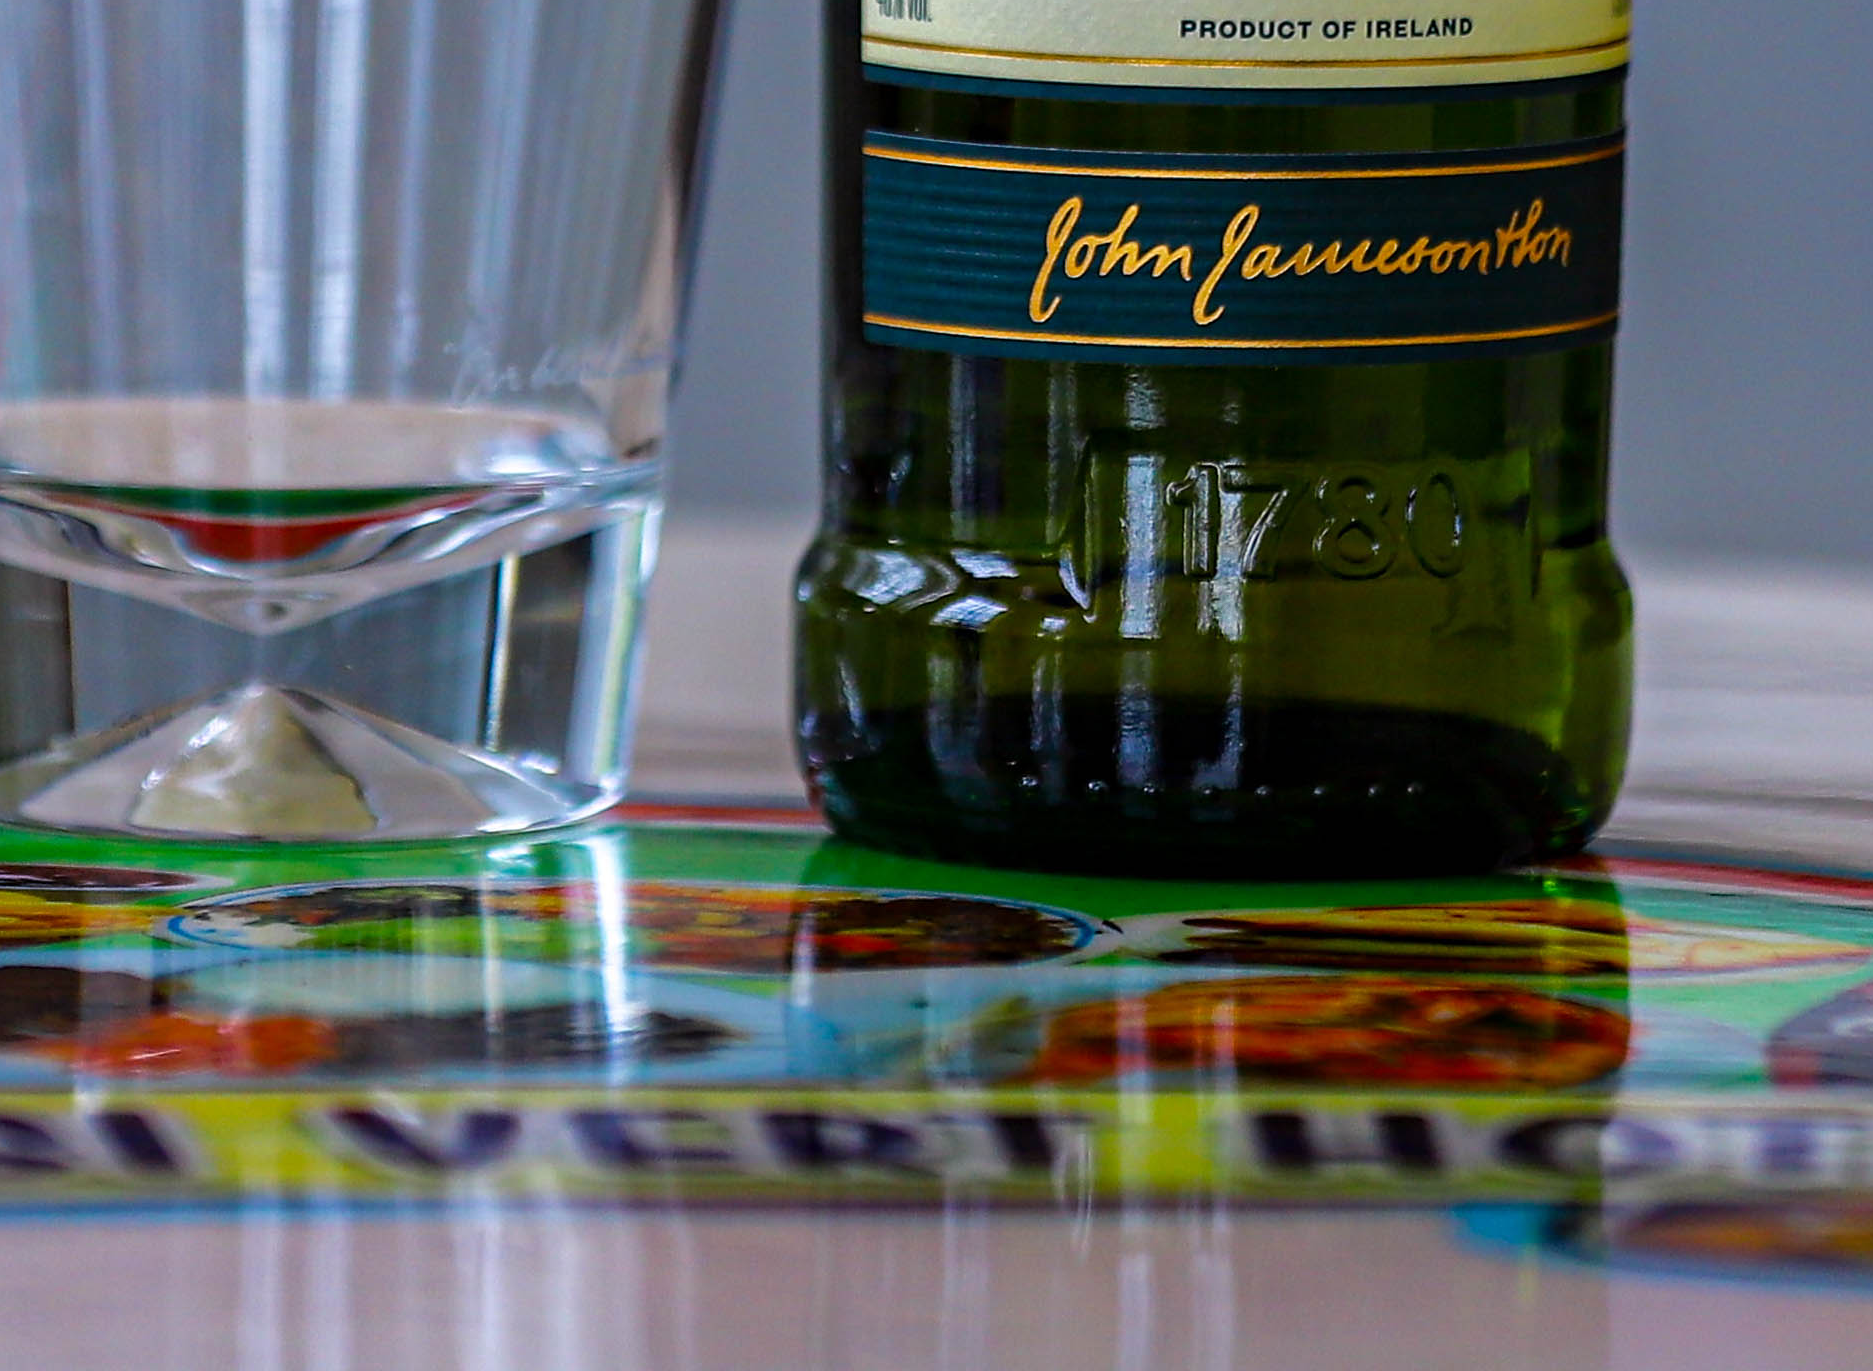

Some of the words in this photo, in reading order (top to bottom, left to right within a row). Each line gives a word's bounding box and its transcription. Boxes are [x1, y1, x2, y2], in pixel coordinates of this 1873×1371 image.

[1180, 18, 1313, 40] PRODUCT
[1322, 19, 1356, 39] OF
[1366, 17, 1473, 39] IRELAND
[1029, 196, 1193, 323] John
[1166, 462, 1464, 581] 1780
